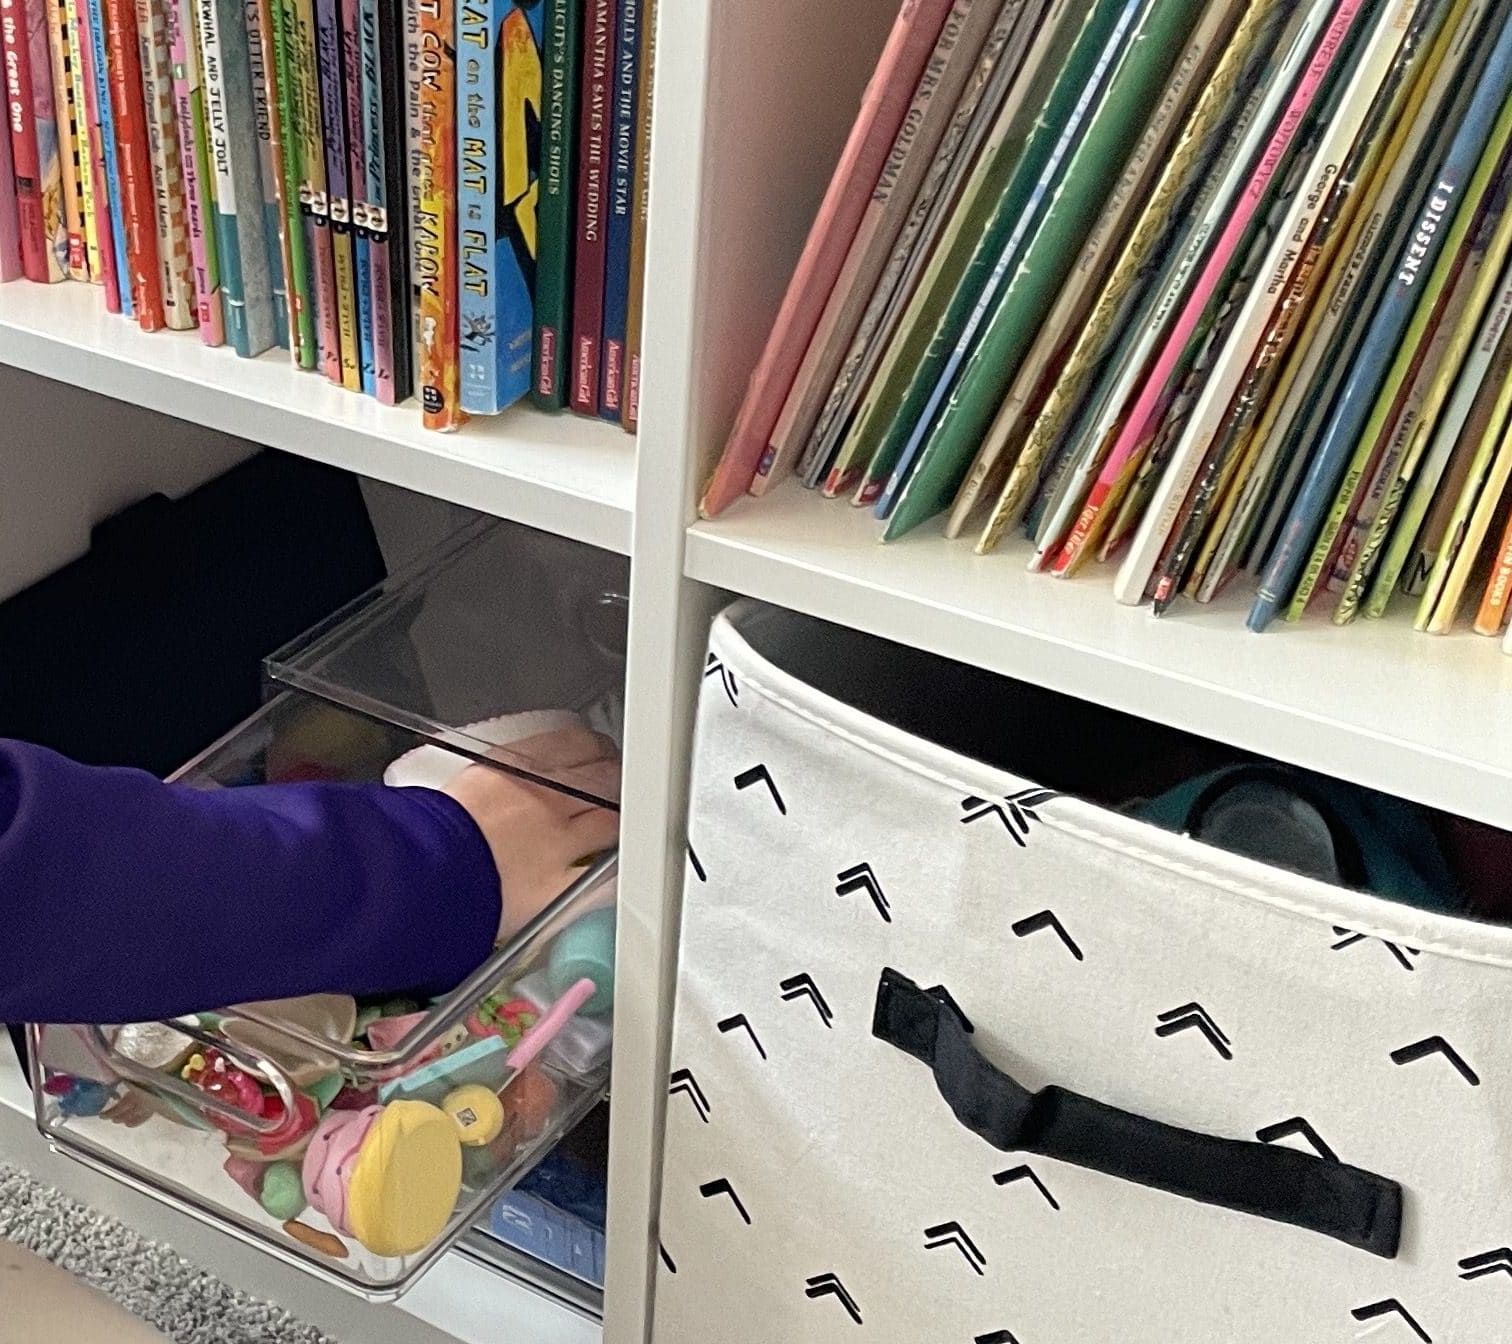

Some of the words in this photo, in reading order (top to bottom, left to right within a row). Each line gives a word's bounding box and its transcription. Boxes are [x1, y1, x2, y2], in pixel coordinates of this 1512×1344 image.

[3, 16, 16, 44] the
[361, 8, 376, 84] BLACK
[938, 12, 969, 51] FOR
[6, 50, 21, 95] Great
[207, 56, 219, 82] AND
[249, 29, 264, 79] OTTER
[408, 43, 418, 70] the
[421, 30, 441, 91] COW
[466, 58, 480, 83] on
[620, 50, 633, 83] AND
[11, 101, 24, 133] One
[209, 87, 227, 132] JELLY
[254, 86, 270, 141] FRIEND
[409, 80, 420, 117] Pain
[467, 93, 485, 128] the
[550, 68, 563, 140] DANCING
[590, 83, 603, 130] SAVES
[618, 88, 632, 117] THE
[215, 138, 229, 176] JOLT
[411, 149, 421, 175] the
[463, 138, 487, 193] MAT
[549, 145, 561, 194] SHOES
[588, 135, 601, 164] THE
[616, 123, 631, 172] MOVIE
[873, 108, 924, 201] GOLDMAN
[585, 168, 600, 241] WEDDING
[615, 177, 629, 214] STAR
[1307, 163, 1337, 210] George
[1439, 181, 1454, 195] I
[468, 204, 482, 220] is
[1292, 217, 1309, 242] and
[418, 211, 443, 296] KAPOW
[1398, 194, 1448, 286] DISSENT
[463, 230, 488, 296] FLAT
[1268, 249, 1297, 294] Martha
